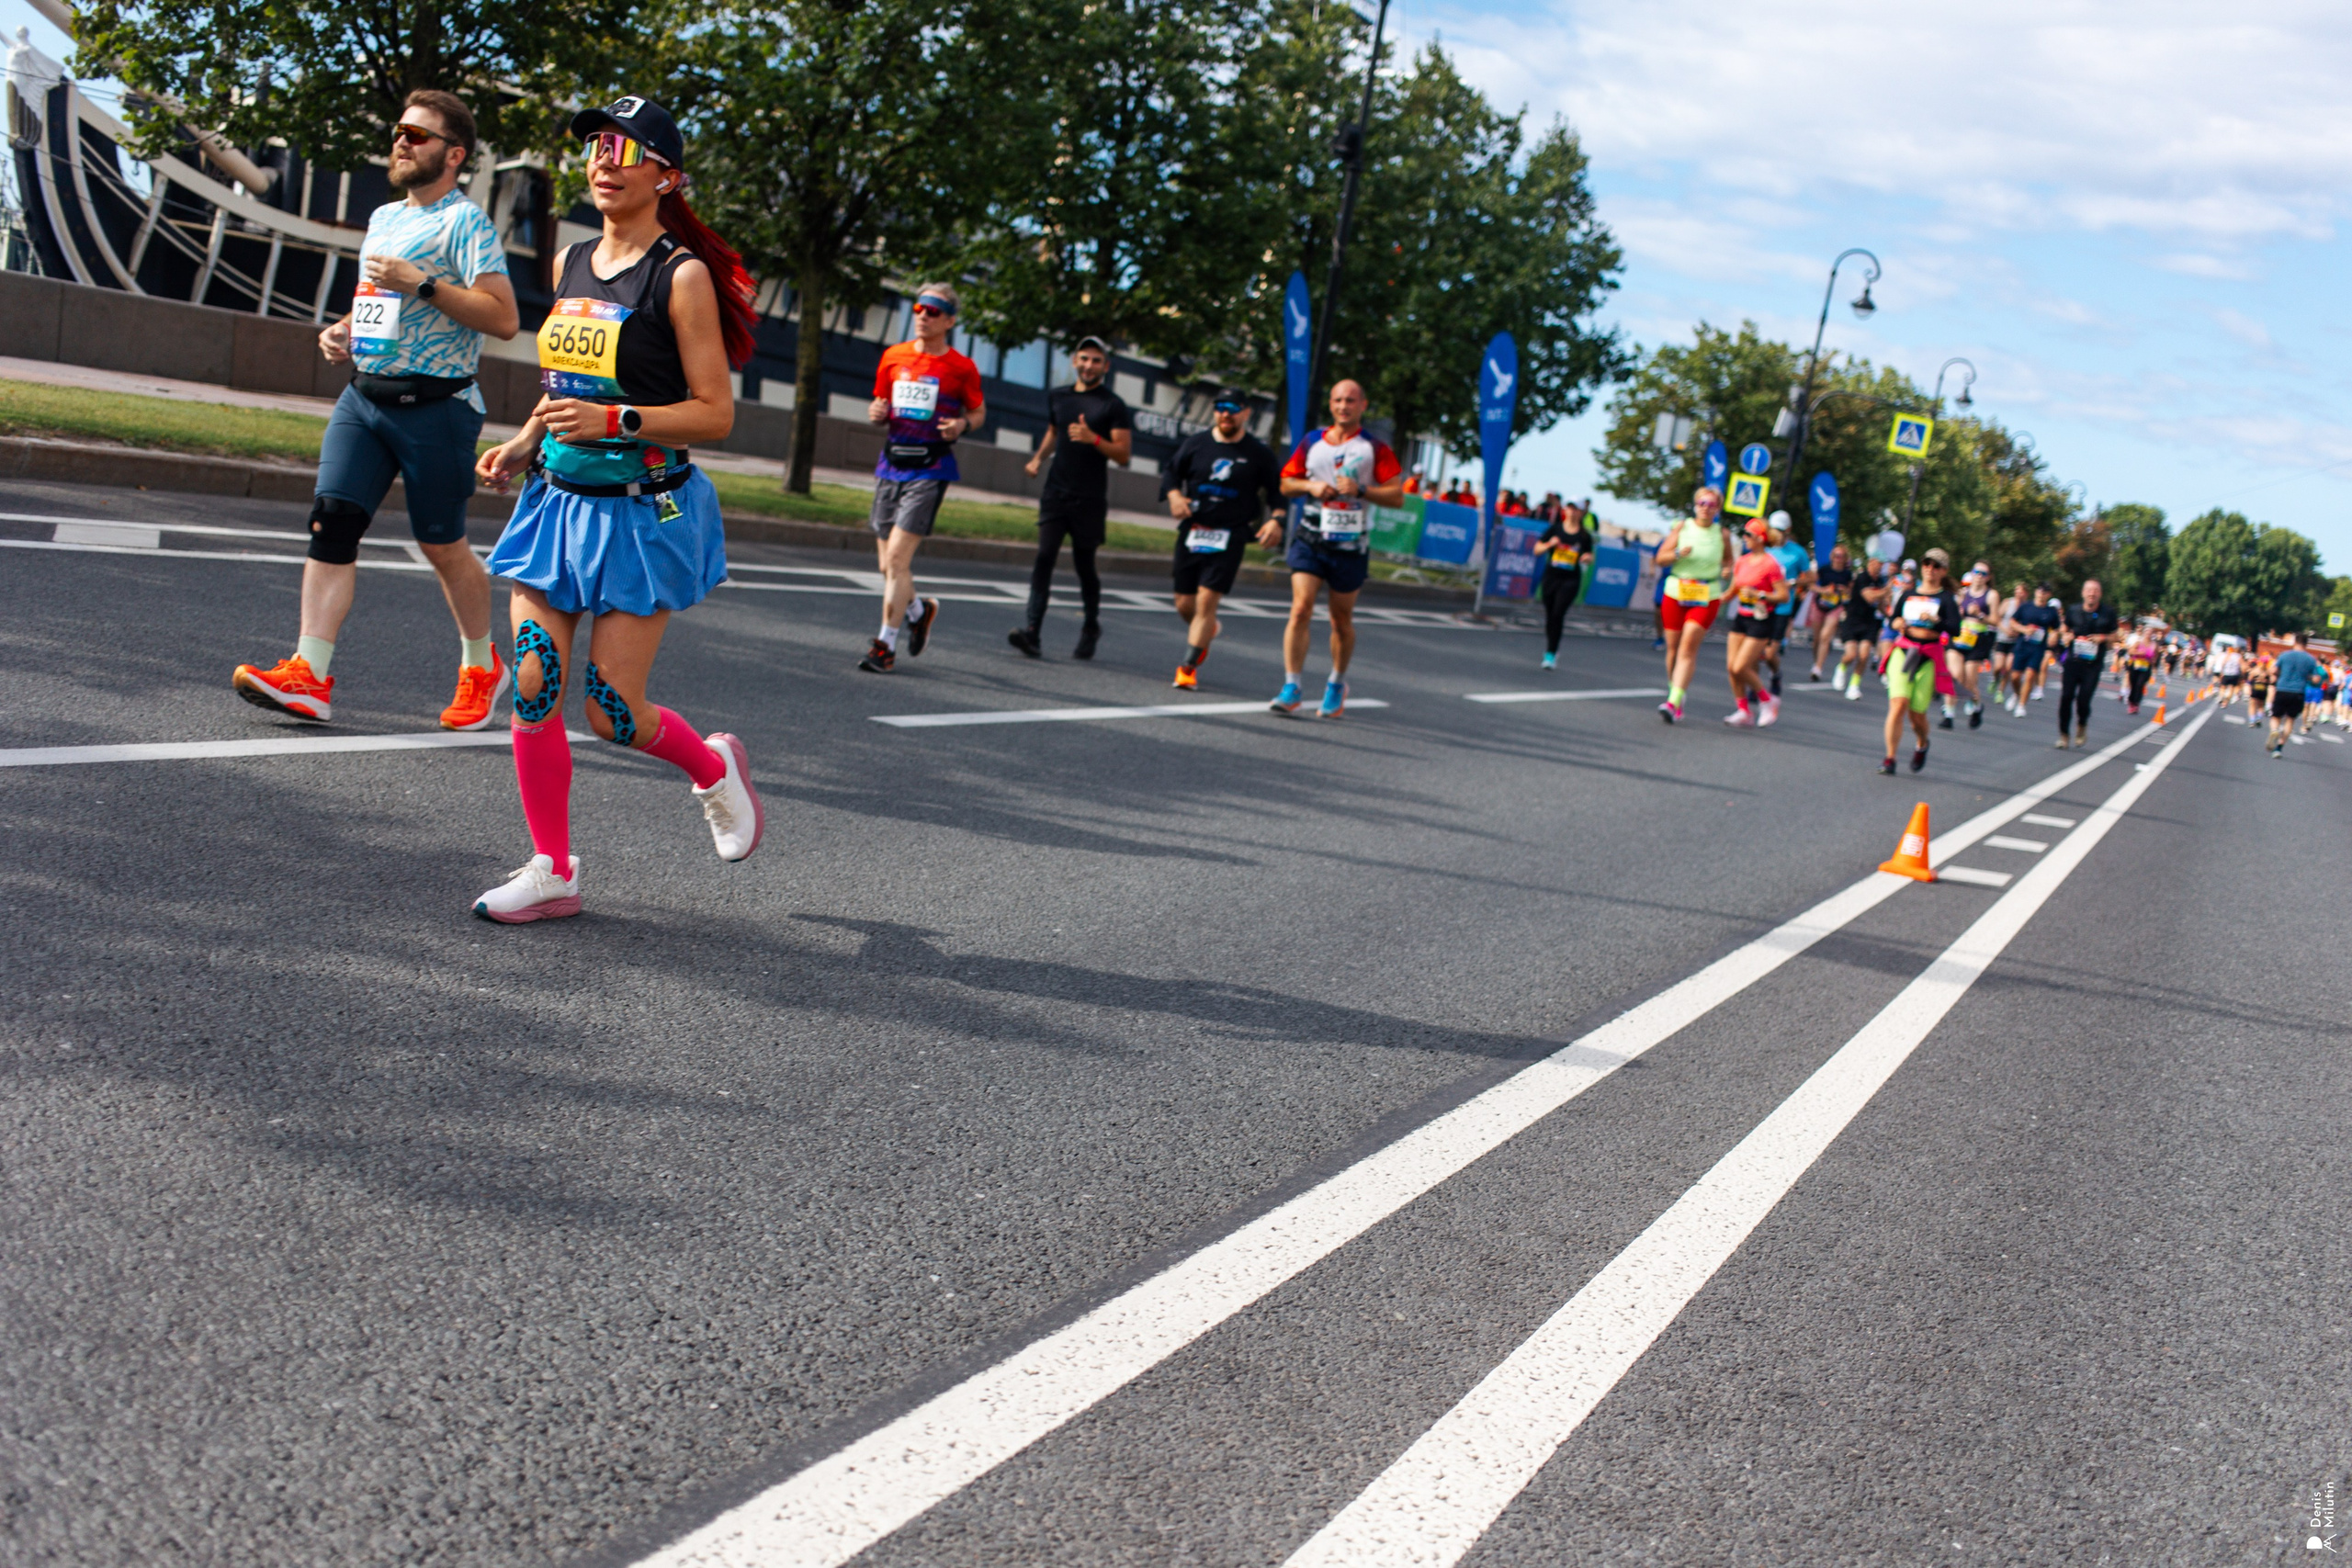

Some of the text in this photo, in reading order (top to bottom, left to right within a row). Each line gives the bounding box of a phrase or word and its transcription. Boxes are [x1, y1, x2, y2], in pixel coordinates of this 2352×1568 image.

[356, 303, 384, 324] 222
[548, 323, 606, 358] 5650
[552, 355, 600, 370] АЛЕКСАНДРА
[898, 386, 930, 401] 3325
